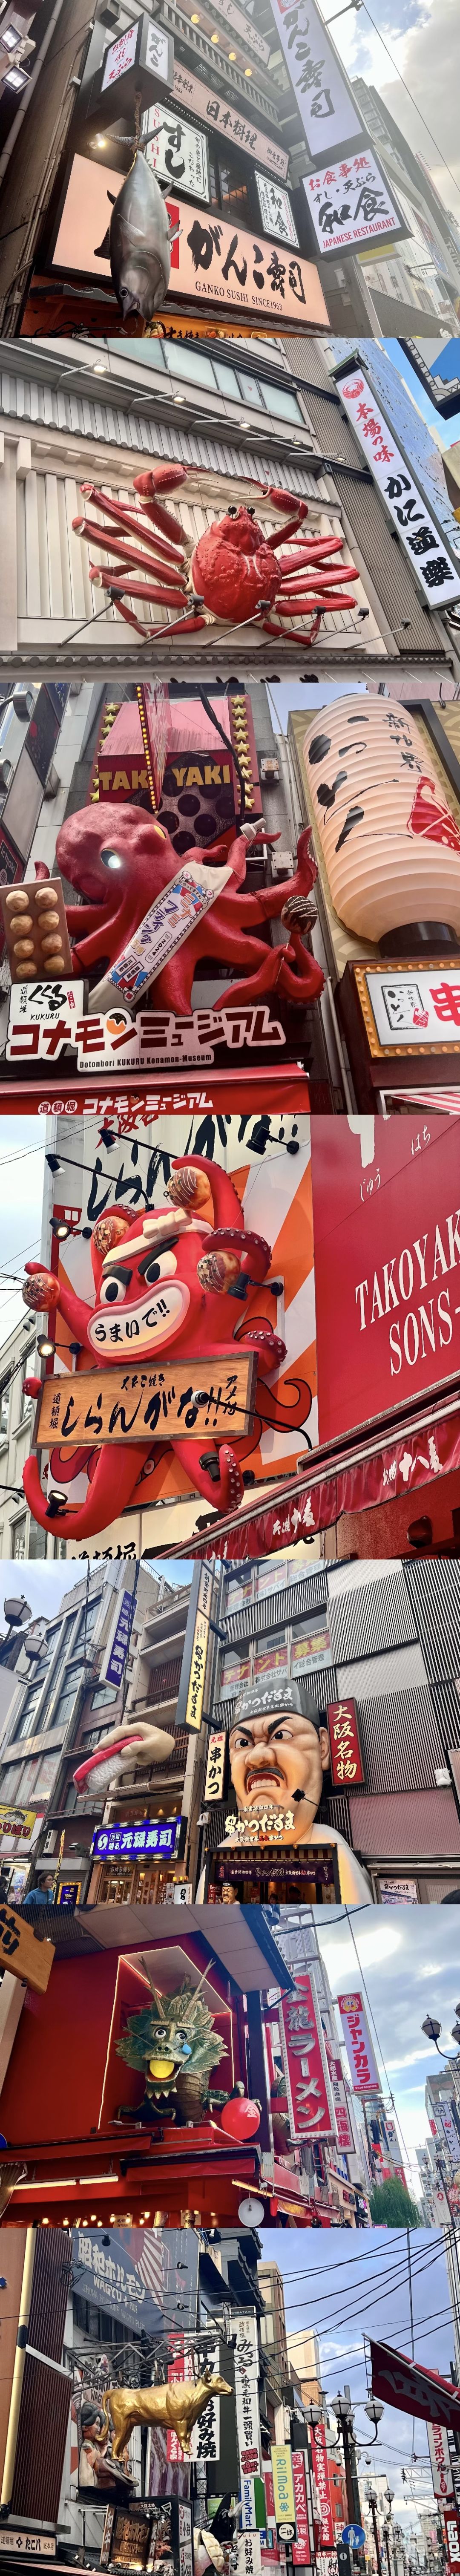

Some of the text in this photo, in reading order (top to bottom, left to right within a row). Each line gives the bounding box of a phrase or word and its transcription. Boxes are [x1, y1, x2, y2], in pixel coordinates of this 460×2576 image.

[149, 33, 166, 67] がんこ
[207, 100, 257, 150] 日本料理
[163, 122, 186, 179] すし
[308, 157, 371, 190] お食事処
[319, 187, 389, 234] 和食
[323, 217, 396, 248] JAPANESE RESTAURANT
[195, 281, 224, 297] GANKO
[227, 289, 249, 303] SUSHI
[356, 403, 394, 463] 本場の味
[385, 474, 454, 588] かに道楽
[382, 712, 424, 772] 新世界
[139, 899, 179, 945] フライング
[168, 893, 196, 928] ミナミ
[152, 939, 166, 956] 2024
[28, 984, 67, 1011] くくる
[10, 1010, 282, 1056] コナモンミュージアム
[80, 1055, 212, 1068] Dotonbori KUKURU Konamon-Museum
[82, 1092, 213, 1115] コナモンミュージアム
[49, 1392, 62, 1429] 道頓堀
[190, 1645, 204, 1719] 串かつだるま
[234, 1687, 293, 1715] 串かつだるま
[210, 1735, 224, 1743] 元祖
[333, 1705, 357, 1780] 大阪名物
[207, 1746, 221, 1795] 串かつ
[121, 1829, 172, 1849] 元禄寿司
[224, 1810, 296, 1837] 串かつだるま
[286, 1982, 326, 2129] 金龍ラーメン
[347, 2014, 371, 2084] ジャンカラ
[78, 2231, 146, 2304] 昭和ホルモン
[94, 2274, 122, 2302] WAGYU
[276, 2458, 289, 2500] Rilmoa
[294, 2473, 306, 2513] アカカベ
[244, 2480, 253, 2527] FamilyMart
[1, 2536, 14, 2545] 道頓堀
[244, 2539, 254, 2574] お好み焼
[446, 2521, 460, 2563] Laox
